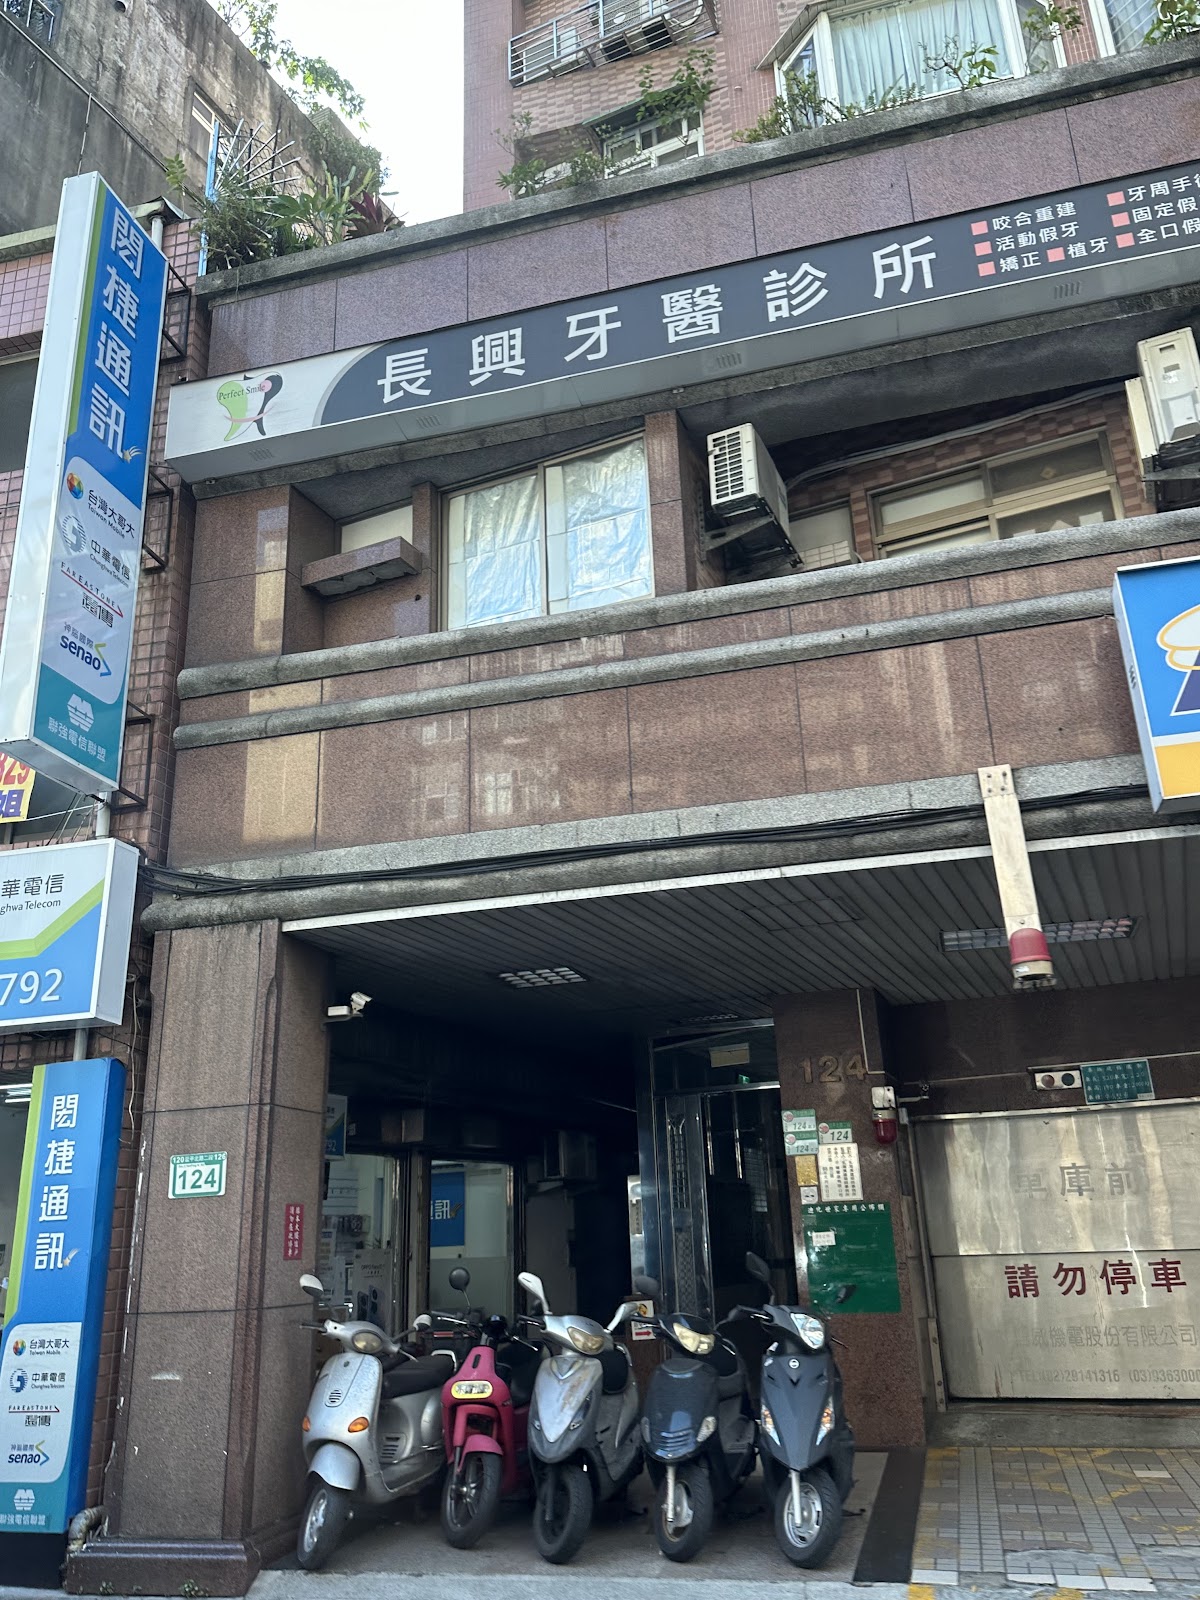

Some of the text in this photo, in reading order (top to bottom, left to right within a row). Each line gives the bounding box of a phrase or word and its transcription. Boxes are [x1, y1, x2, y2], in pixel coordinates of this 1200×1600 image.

[992, 201, 1077, 232] 咬合重建
[1132, 195, 1200, 224] 固定假
[996, 221, 1080, 253] 活動假牙
[999, 237, 1109, 273] 矯正 植牙
[377, 235, 937, 404] 長興牙醫診所
[218, 383, 266, 401] Perfect Smile
[88, 489, 135, 539] 台灣大哥大
[88, 502, 125, 539] Taiwan Mobile
[90, 554, 112, 576] Chunghwa
[91, 540, 130, 580] 中華電信
[60, 635, 101, 671] senao
[48, 717, 106, 762] 聯強電信聯盟
[1, 874, 64, 898] 華電信
[25, 899, 61, 911] Telecom
[799, 1054, 867, 1084] 124
[830, 1130, 849, 1141] 124
[172, 1156, 184, 1164] 120
[179, 1168, 216, 1190] 124
[431, 1199, 450, 1220] 訊
[1004, 1258, 1187, 1299] 請勿停車
[30, 1338, 69, 1350] 台灣大哥大
[32, 1372, 66, 1382] 中華電信
[8, 1453, 41, 1464] senao
